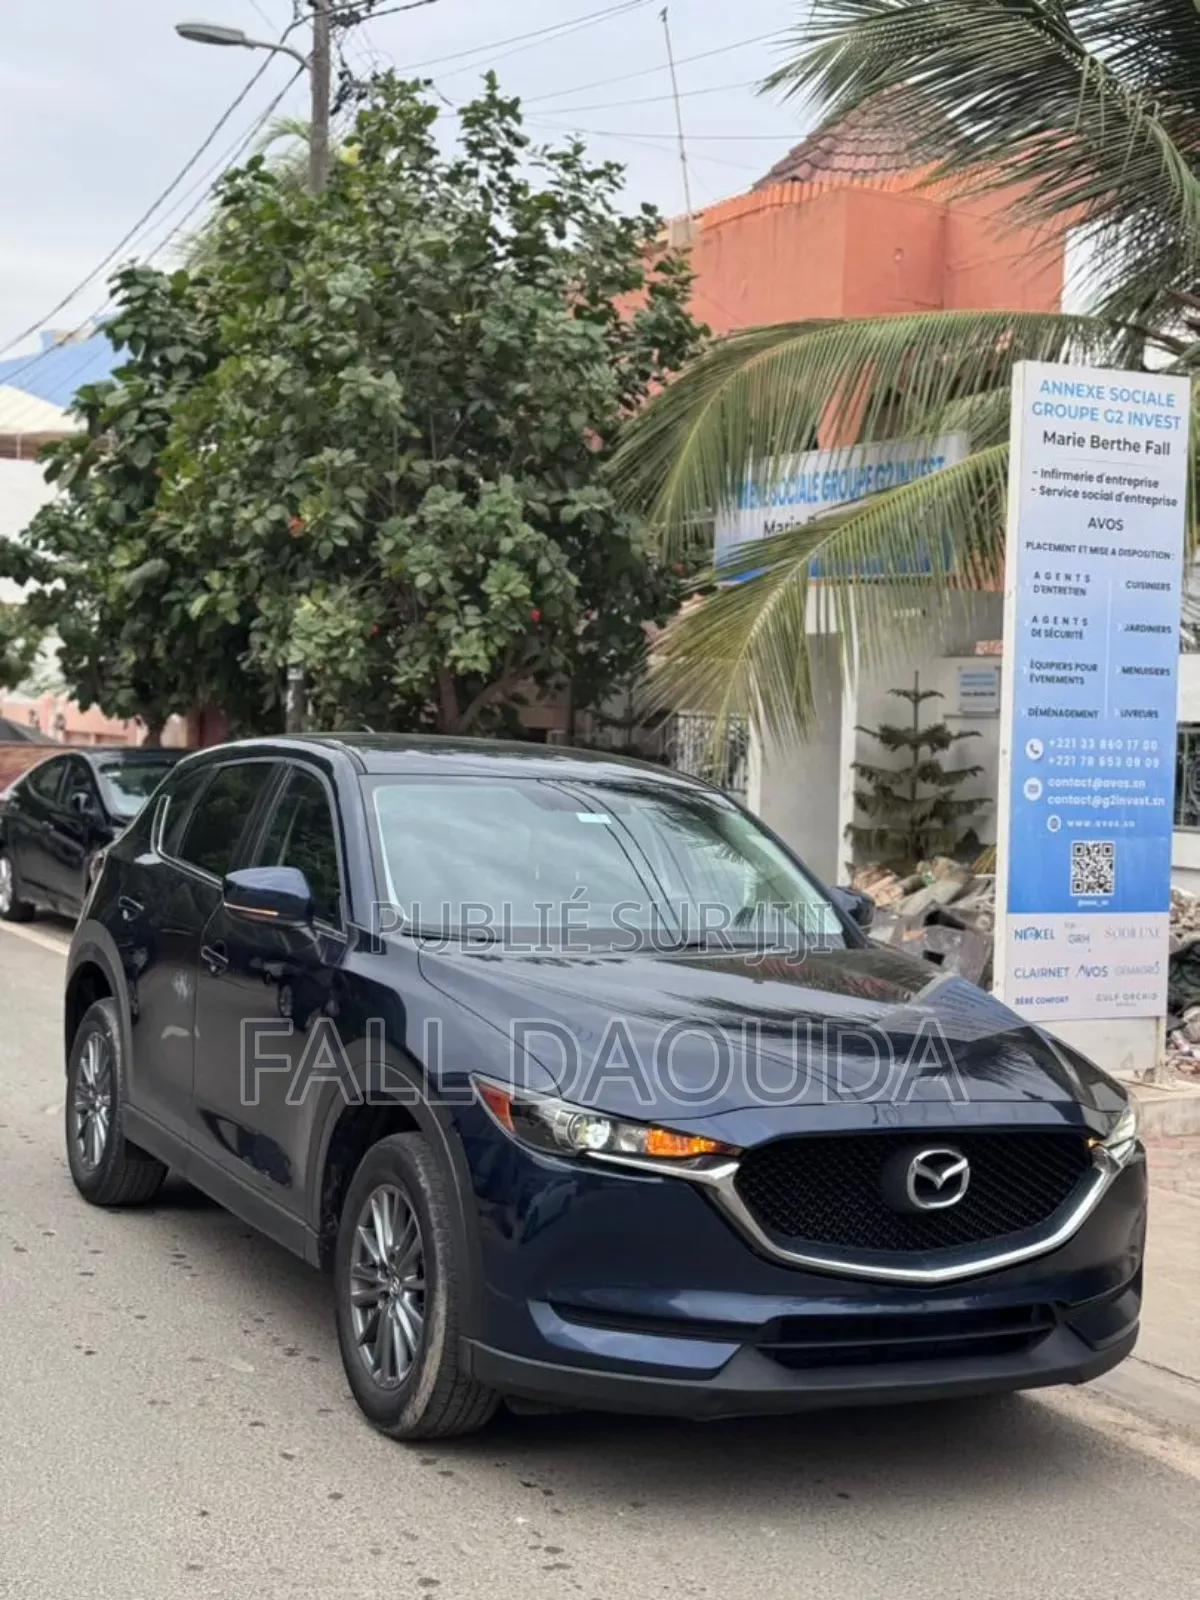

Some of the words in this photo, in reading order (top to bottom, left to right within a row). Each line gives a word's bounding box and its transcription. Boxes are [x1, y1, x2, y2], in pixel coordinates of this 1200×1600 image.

[1040, 380, 1105, 400] ANNEXE
[1109, 387, 1176, 408] SOCIALE
[1031, 401, 1099, 422] GROUPE
[1103, 408, 1124, 425] G2
[1128, 411, 1182, 430] INVEST
[1043, 430, 1086, 448] Marie
[1090, 434, 1141, 454] Berthe
[1145, 440, 1171, 456] Fall
[1040, 467, 1094, 483] Infirmerie
[1096, 473, 1160, 490] d'entreprise
[1039, 485, 1080, 499] Service
[1081, 487, 1113, 502] social
[1115, 491, 1178, 508] d'entreprise
[1087, 516, 1124, 532] AVOS
[1026, 541, 1076, 554] PLACEMENT
[1078, 545, 1087, 554] ET
[1089, 546, 1109, 556] MISE
[1033, 584, 1087, 597] D'ENTRETIEN
[1125, 580, 1172, 592] CUISINIERS
[1031, 628, 1042, 638] DE
[1124, 624, 1172, 634] JARDINIERS
[1074, 662, 1098, 672] POUR
[1121, 666, 1171, 677] MENUISIERS
[1120, 709, 1159, 719] LIVREURS
[1014, 966, 1070, 980] CLAIRNET
[1075, 964, 1109, 979] AVOS
